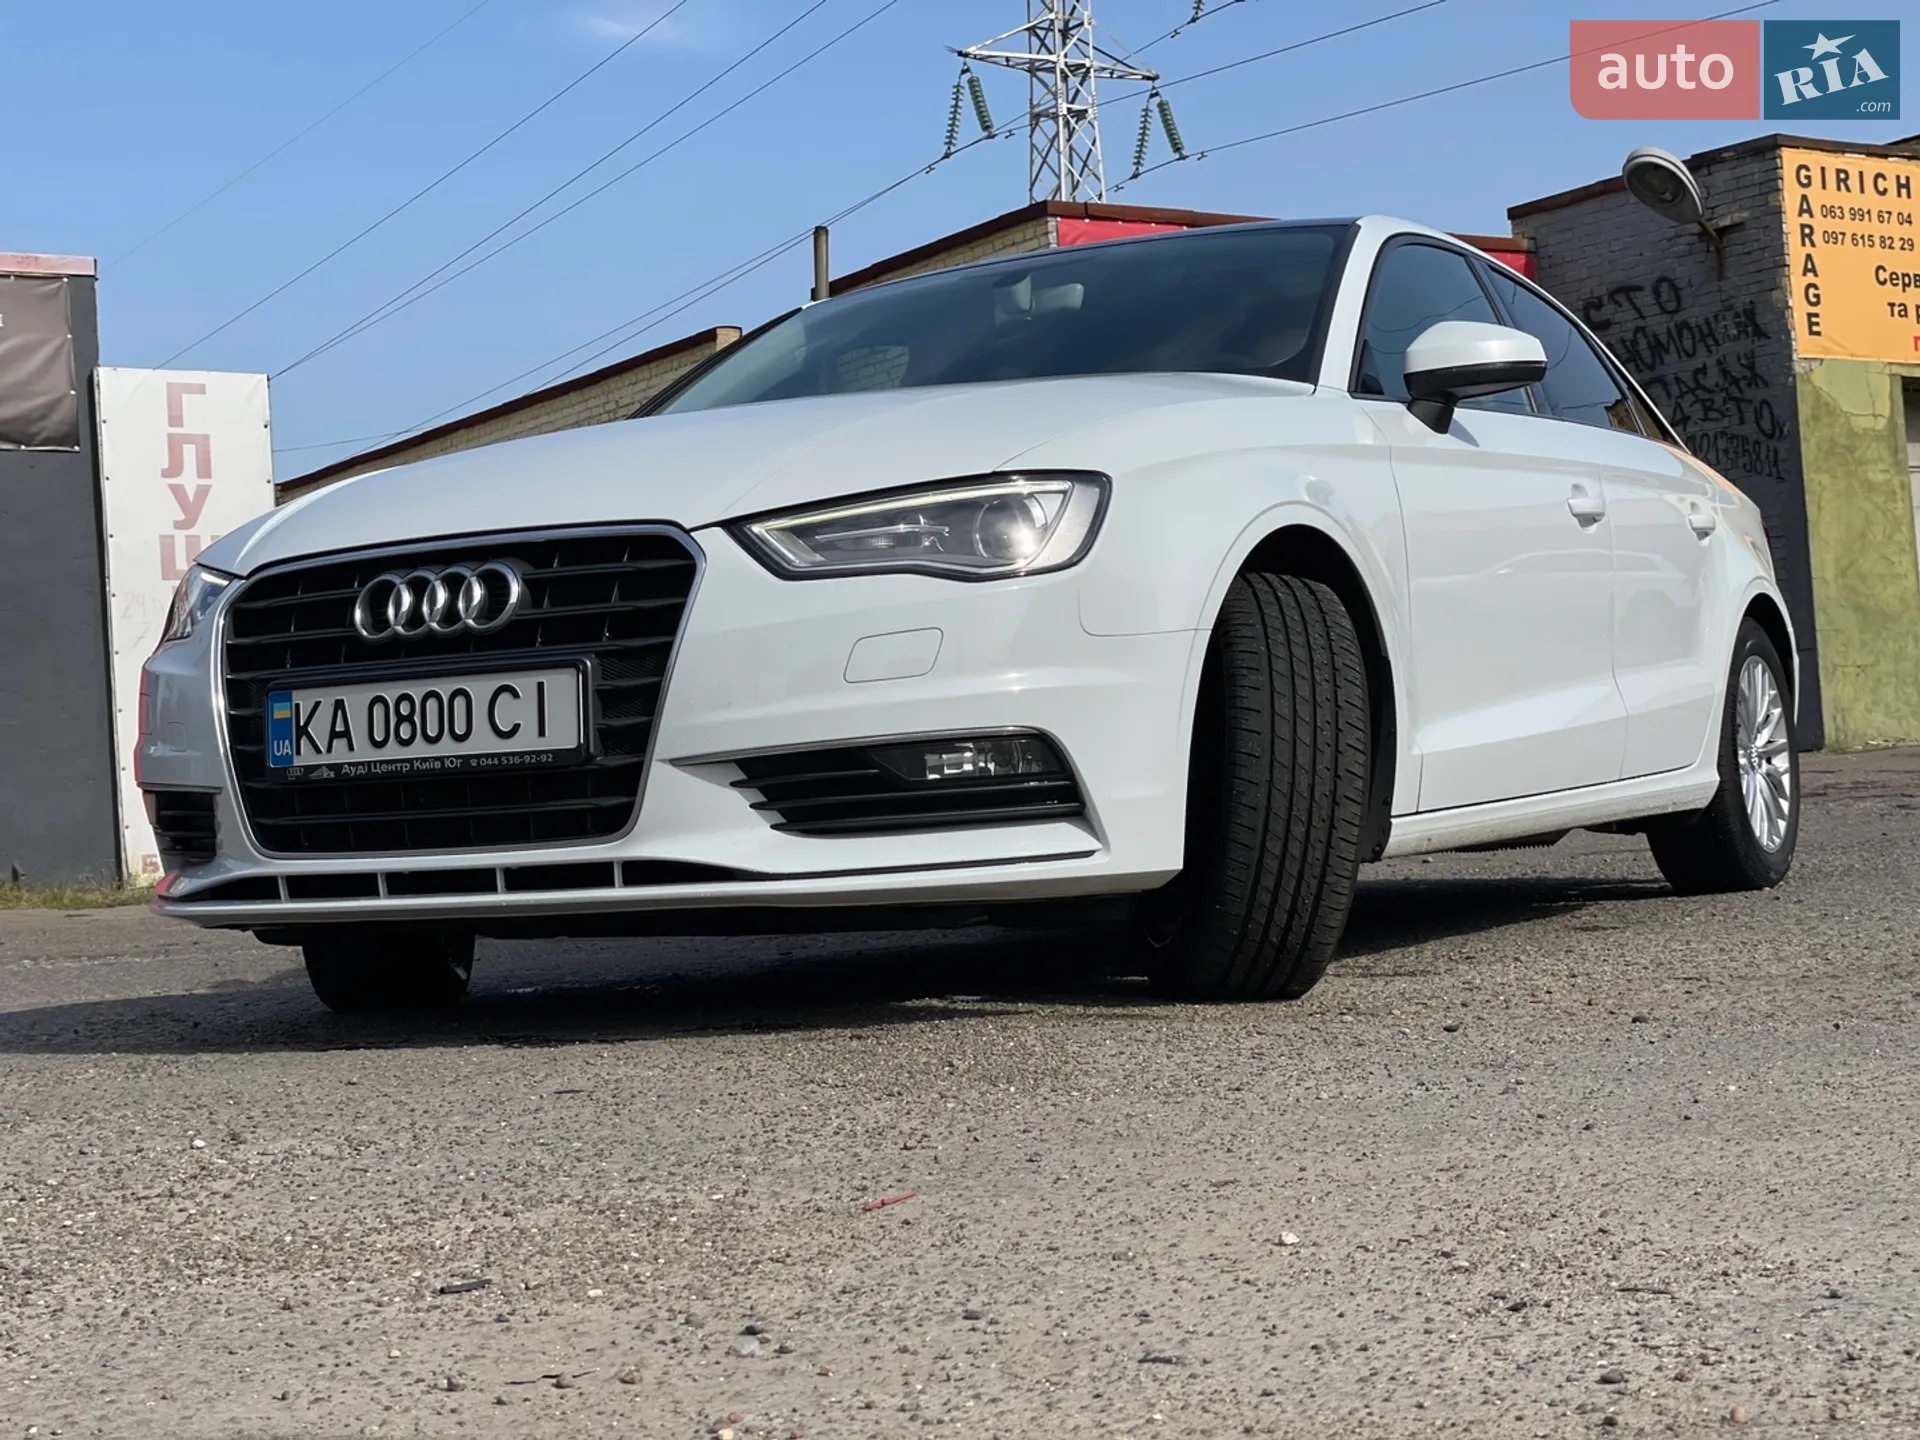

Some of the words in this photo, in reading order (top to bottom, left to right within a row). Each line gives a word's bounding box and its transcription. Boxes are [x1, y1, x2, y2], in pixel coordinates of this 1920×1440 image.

[1795, 164, 1912, 199] GIRICH
[1820, 204, 1845, 220] 063
[1849, 206, 1872, 223] 991
[1877, 209, 1892, 224] 67
[1897, 211, 1913, 226] 04
[1795, 164, 1822, 336] GARAGE
[1822, 230, 1847, 246] 097
[1851, 232, 1875, 248] 615
[1879, 235, 1895, 250] 82
[1899, 237, 1915, 251] 29
[1887, 301, 1909, 318] та
[294, 698, 356, 757] KA
[368, 687, 475, 749] 0800
[273, 739, 292, 756] UA
[341, 762, 368, 776] Ауді
[371, 761, 411, 773] Центр
[413, 759, 441, 770] Київ
[444, 757, 463, 768] Юг
[479, 757, 499, 767] 044
[501, 754, 554, 766] 536-92-92
